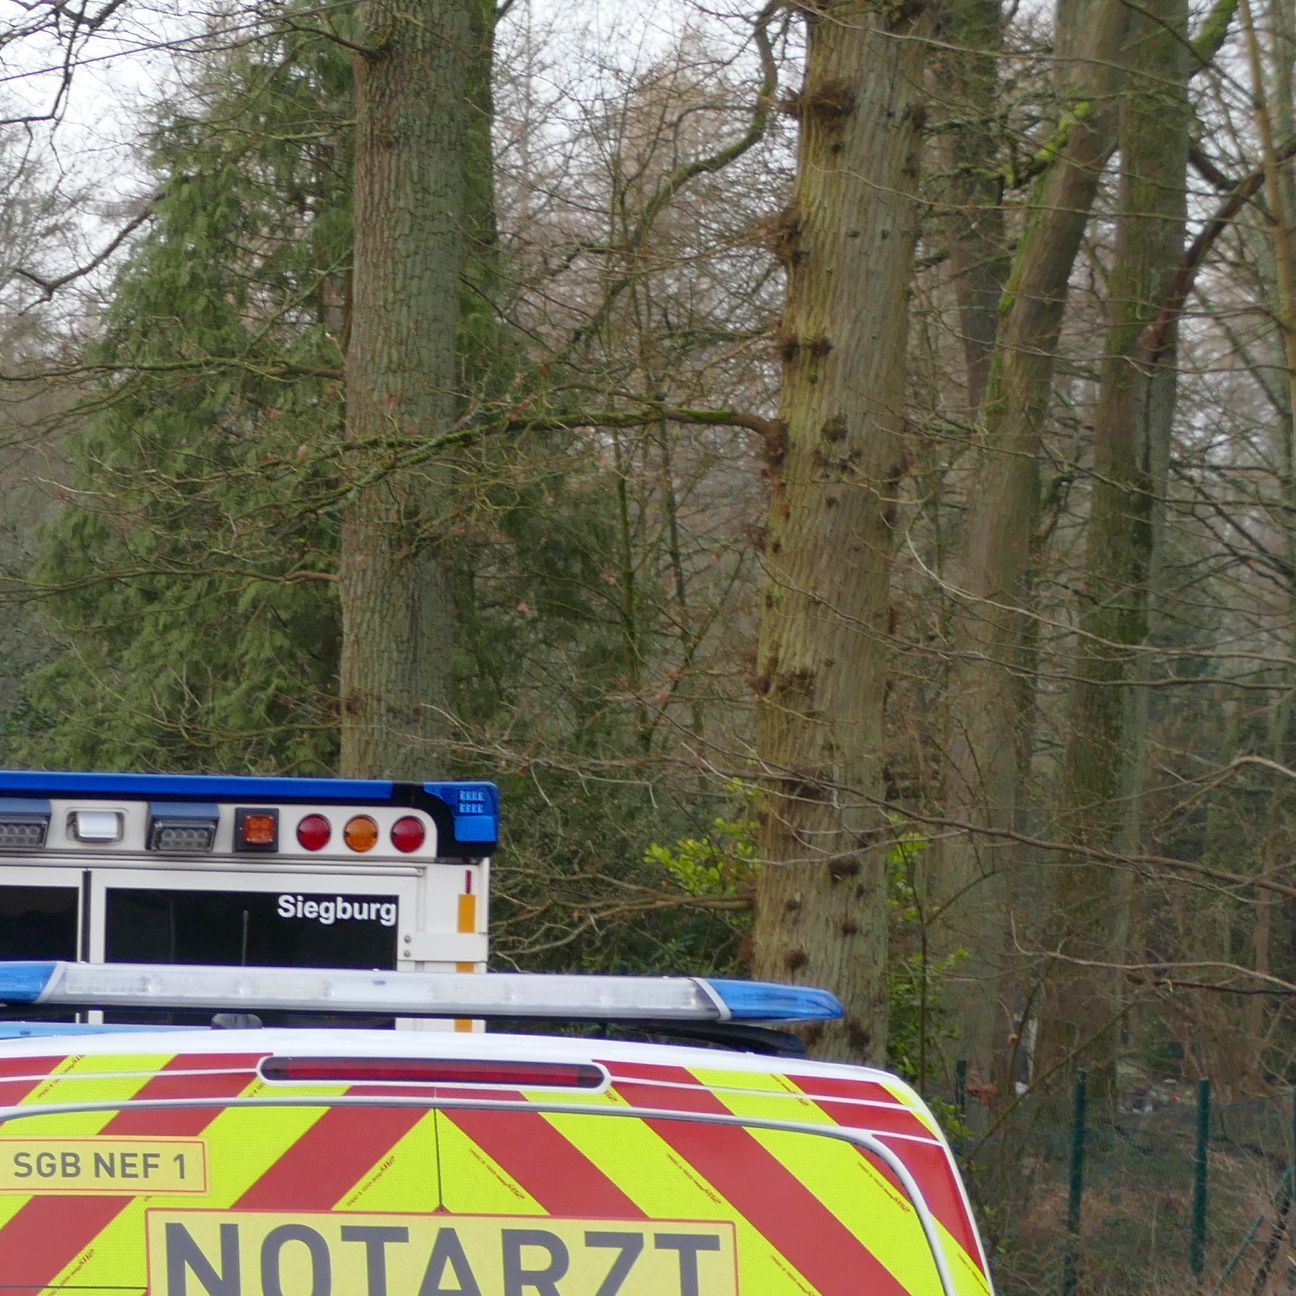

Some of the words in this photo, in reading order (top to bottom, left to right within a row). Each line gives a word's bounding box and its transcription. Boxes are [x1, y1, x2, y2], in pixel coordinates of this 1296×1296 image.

[277, 894, 397, 927] Siegburg
[13, 1151, 81, 1178] SGB
[93, 1152, 161, 1179] NEF
[173, 1153, 186, 1180] 1
